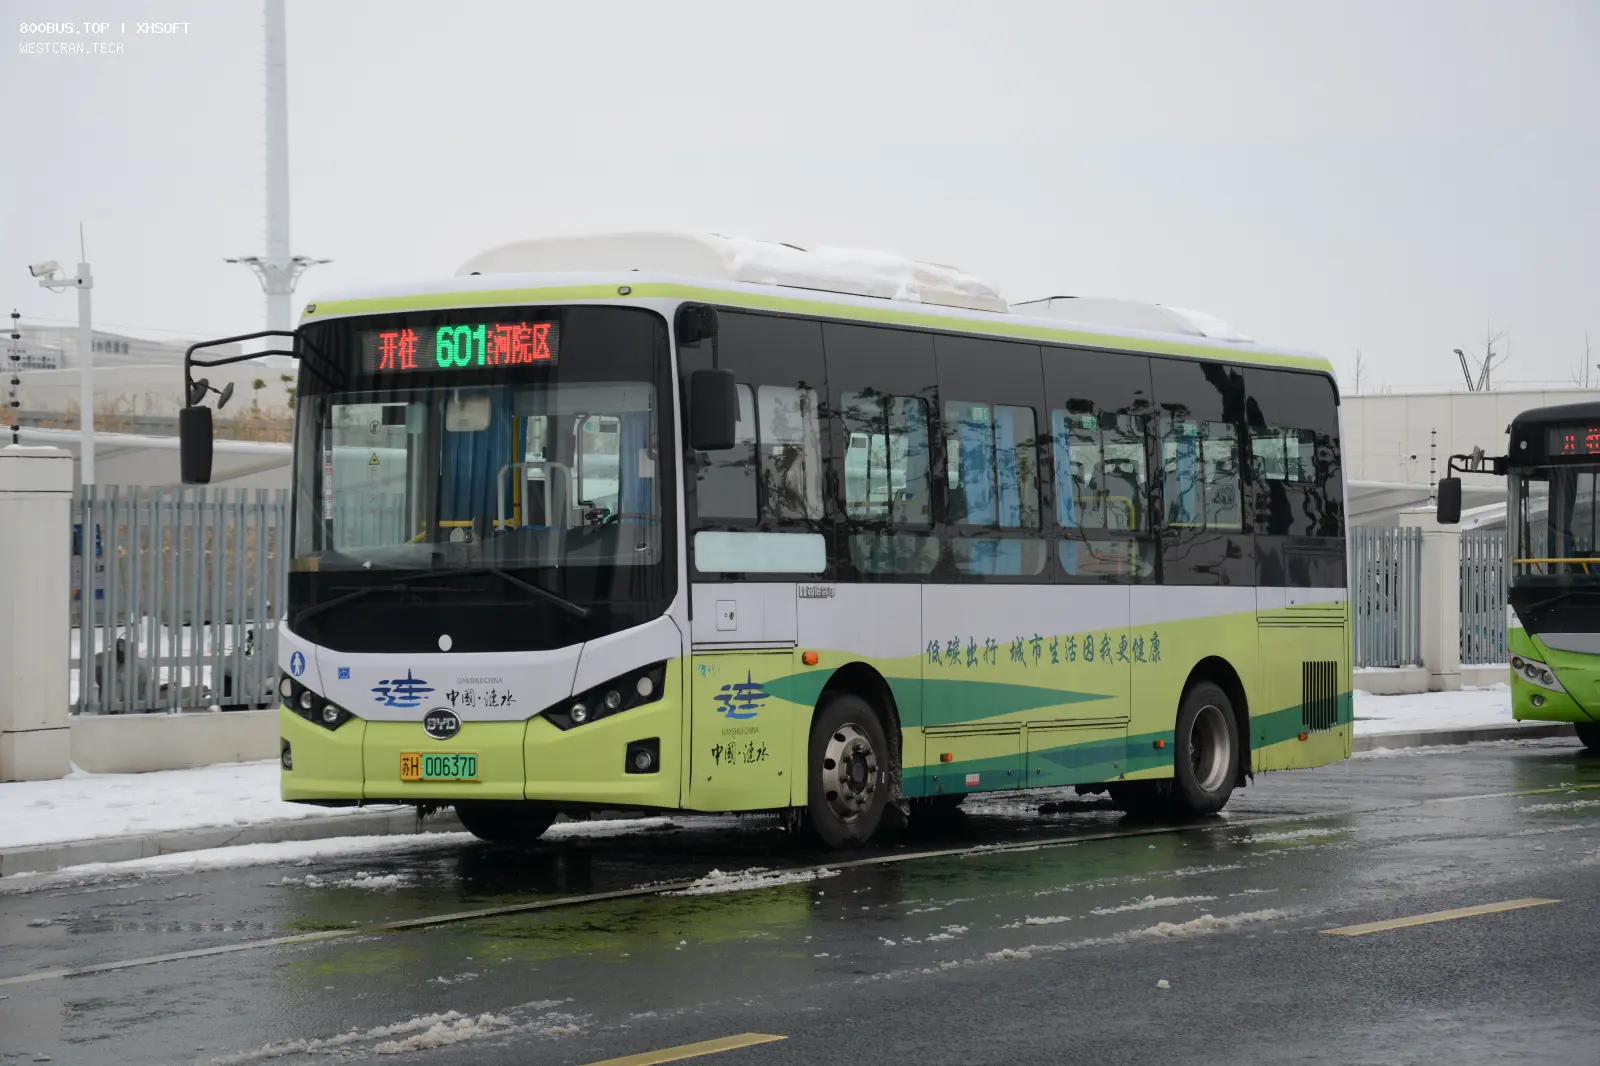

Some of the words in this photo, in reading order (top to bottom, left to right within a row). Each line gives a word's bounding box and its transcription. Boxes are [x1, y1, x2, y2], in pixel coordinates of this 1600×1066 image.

[378, 328, 419, 370] 开往
[435, 324, 487, 368] 601
[486, 321, 552, 366] 河院区
[926, 635, 999, 668] 低碳出行
[1009, 630, 1162, 668] 城市生活因我更健康
[426, 717, 456, 731] BYD
